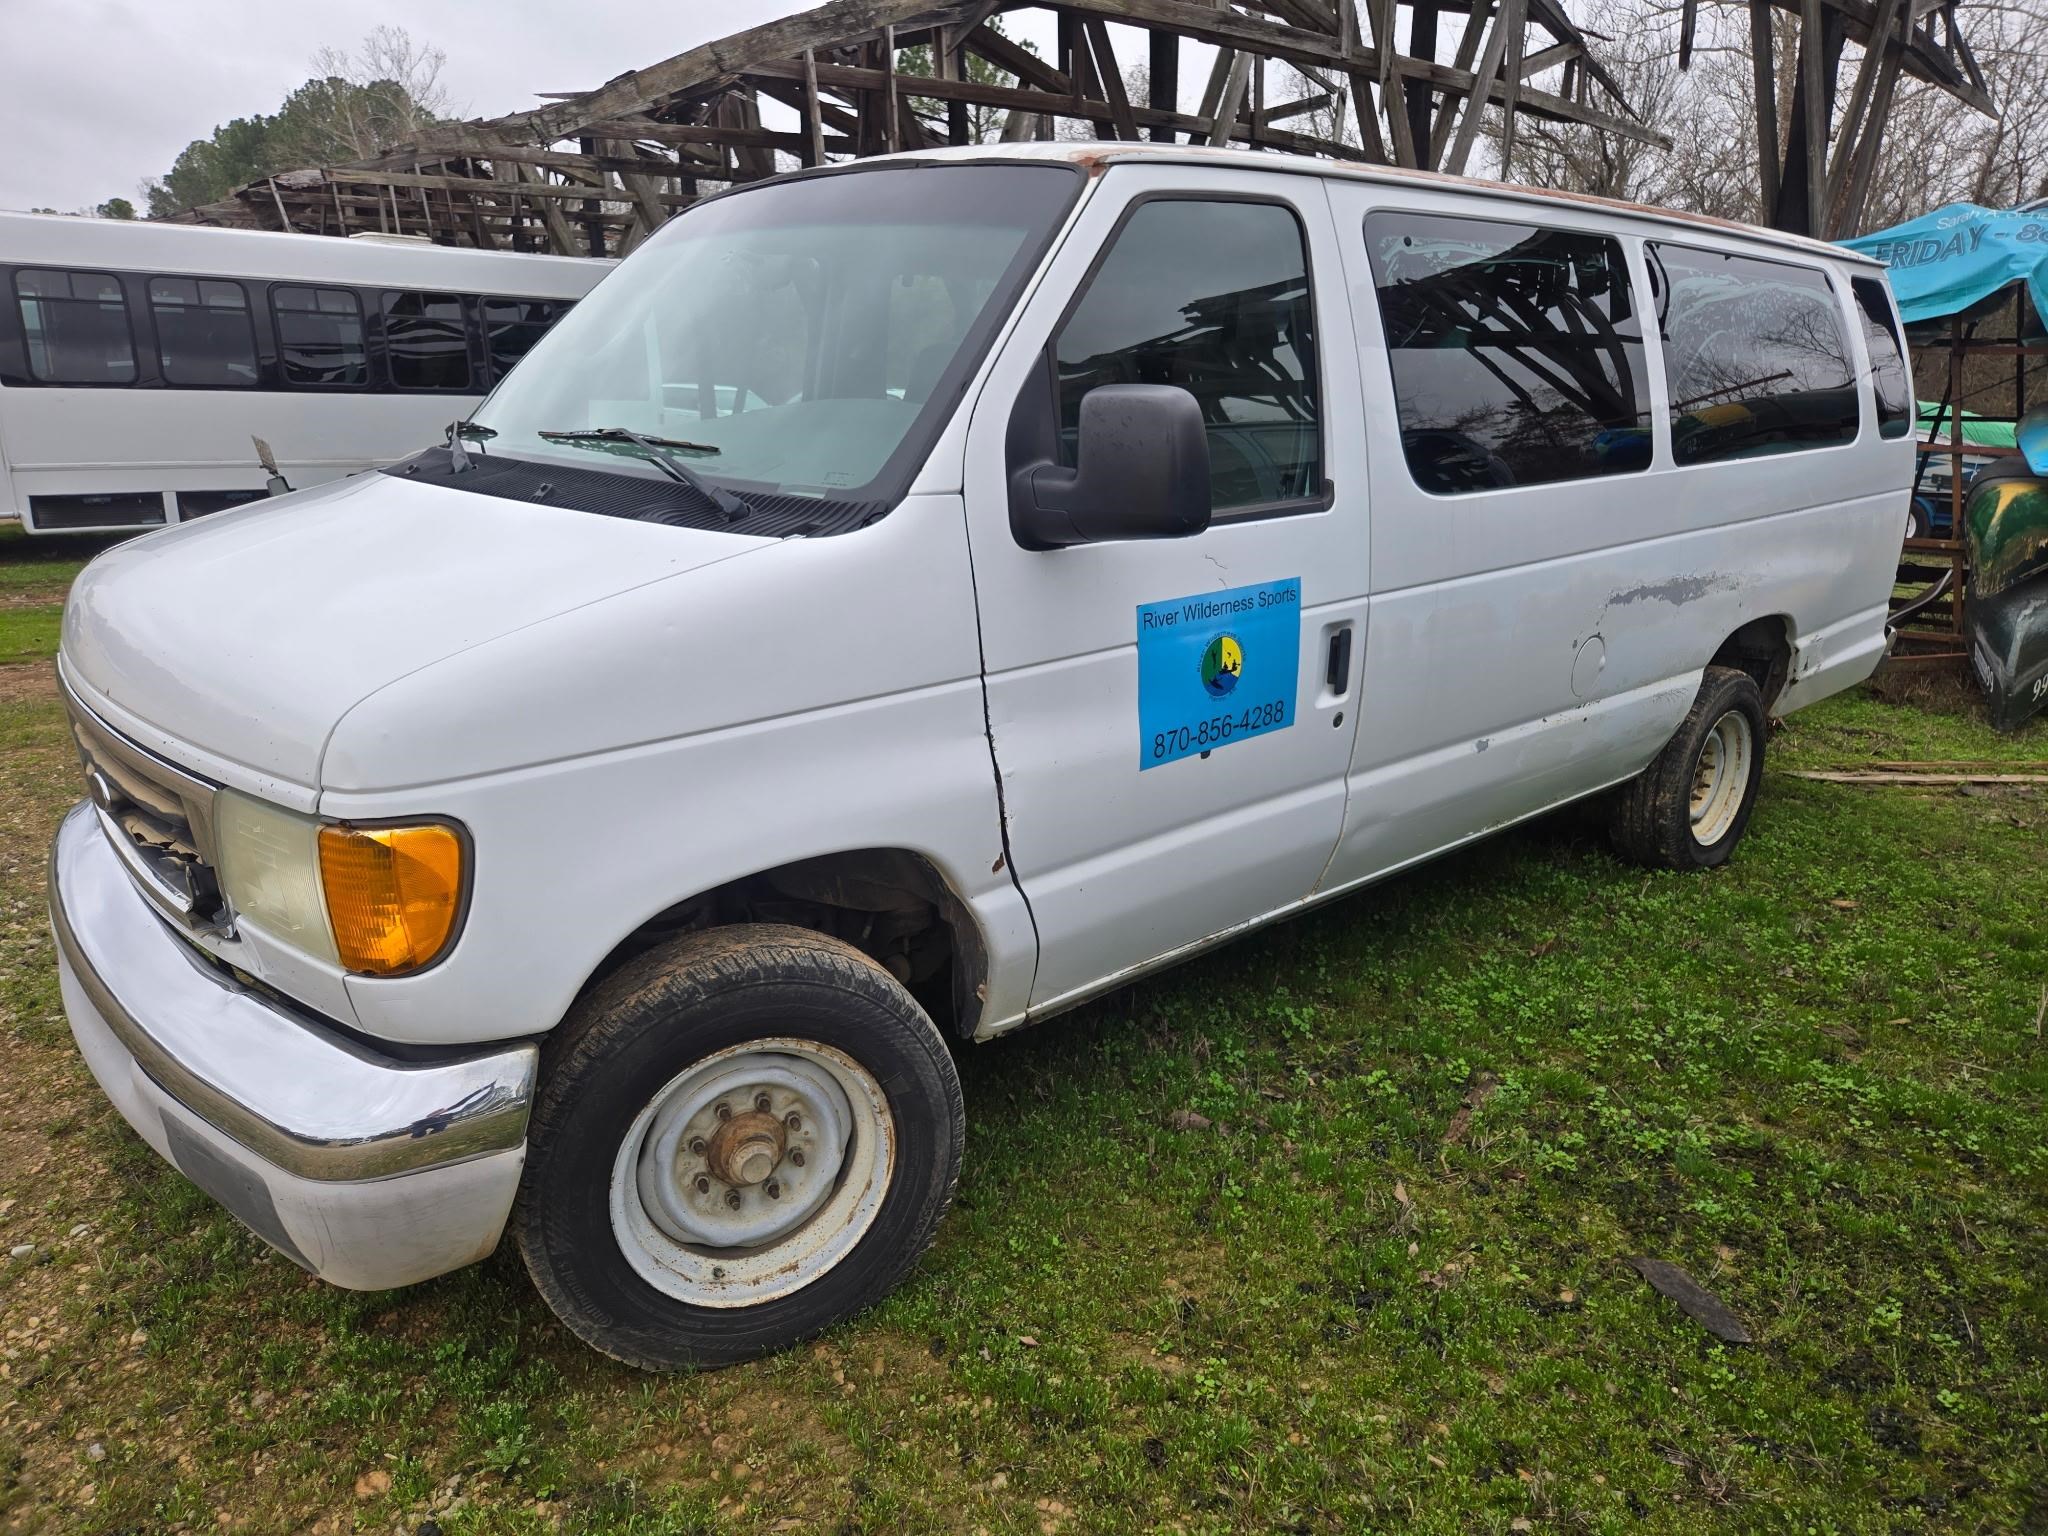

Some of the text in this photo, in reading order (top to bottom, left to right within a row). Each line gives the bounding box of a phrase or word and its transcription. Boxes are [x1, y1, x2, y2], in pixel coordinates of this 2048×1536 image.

[1936, 210, 1980, 231] Sarah
[1874, 223, 1990, 270] FRIDAY
[1143, 588, 1296, 630] River Wilderness Sports
[1153, 700, 1285, 759] 870-856-4288
